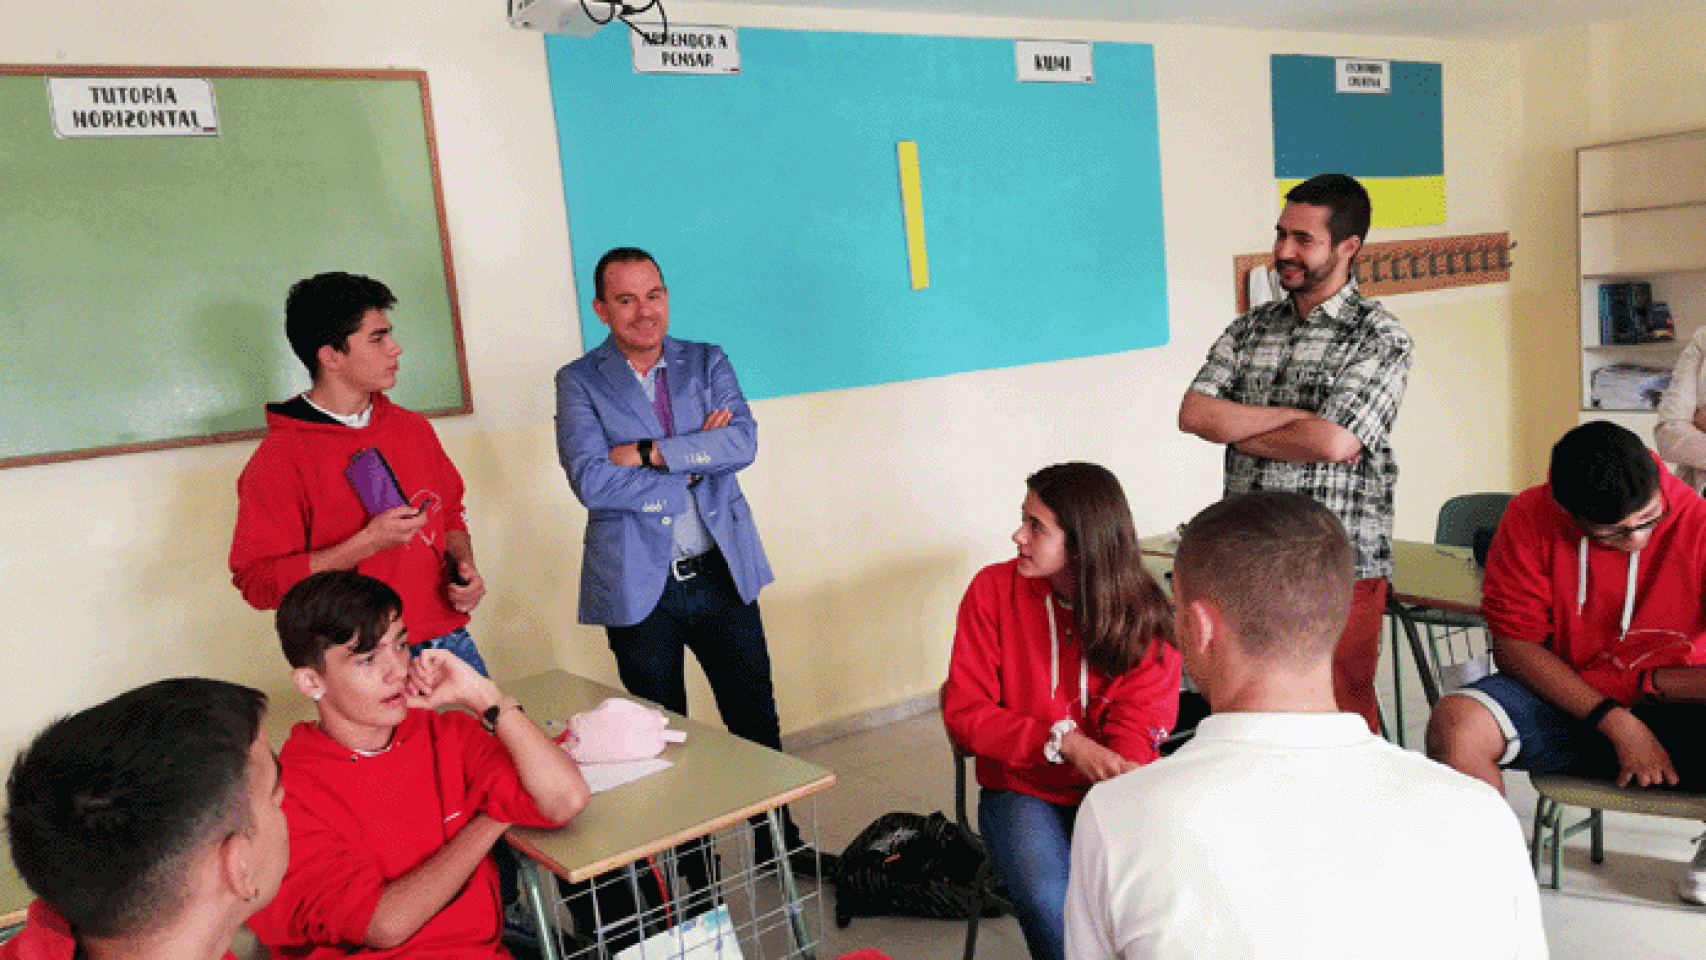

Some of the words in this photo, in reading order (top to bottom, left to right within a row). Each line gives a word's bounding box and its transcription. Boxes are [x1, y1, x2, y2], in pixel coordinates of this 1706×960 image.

[717, 33, 729, 49] A
[661, 50, 713, 67] PENSAR
[88, 84, 177, 105] TUTORÍA
[72, 110, 201, 128] HORIZONTAL
